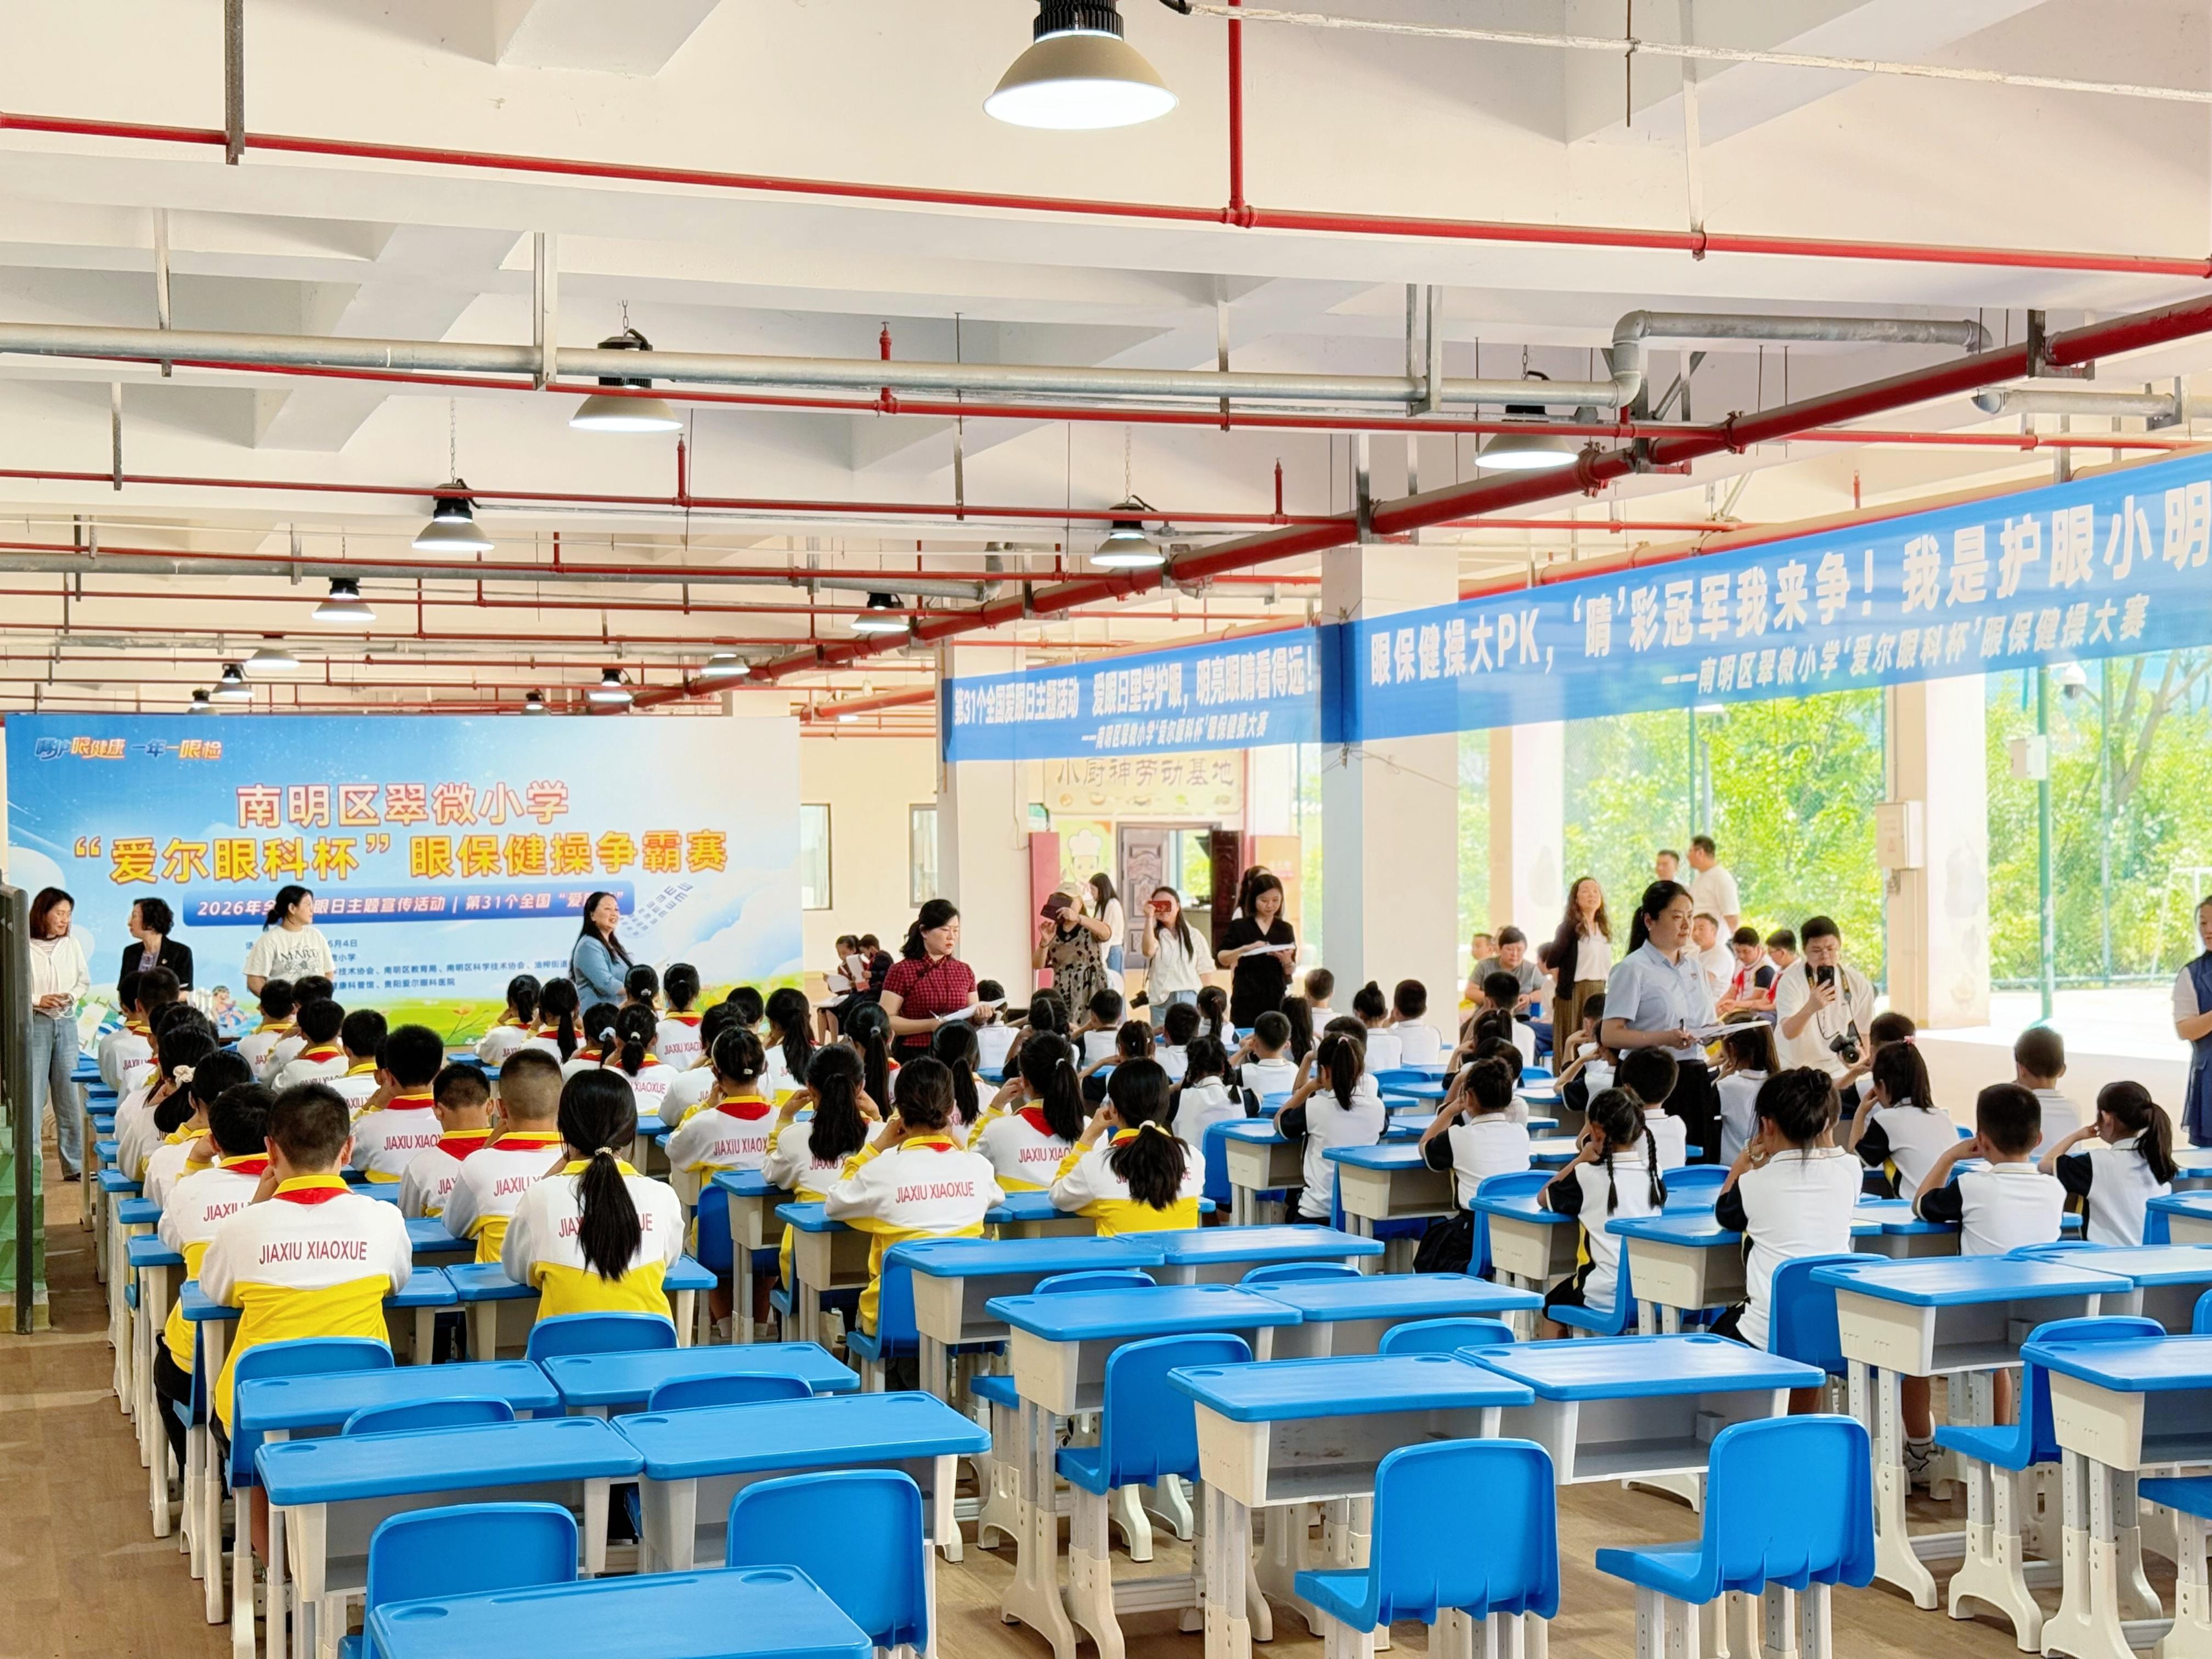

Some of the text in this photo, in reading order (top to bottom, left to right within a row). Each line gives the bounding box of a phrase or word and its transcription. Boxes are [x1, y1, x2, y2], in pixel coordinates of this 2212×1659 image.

[954, 676, 1079, 726] 第31个全国爱眼日主题活动
[1057, 757, 1234, 787] 小厨神劳动基地
[236, 780, 569, 828] 南明区翠微小学
[75, 829, 729, 884] “爱尔眼科杯” 眼保健操争霸赛
[197, 895, 446, 916] 2026年全眼日主题宣传活动
[465, 890, 624, 911] 第31个全国“爱”
[635, 1081, 665, 1094] XIAOXUE
[384, 1135, 413, 1151] JIAXIU
[713, 1137, 768, 1156] JIAXIU XIAOX
[1018, 1147, 1071, 1163] JIAXIU XIAO
[895, 1181, 975, 1204] JIAXIU XIAOXUE
[259, 1240, 368, 1265] JIAXIU XIAOXUE
